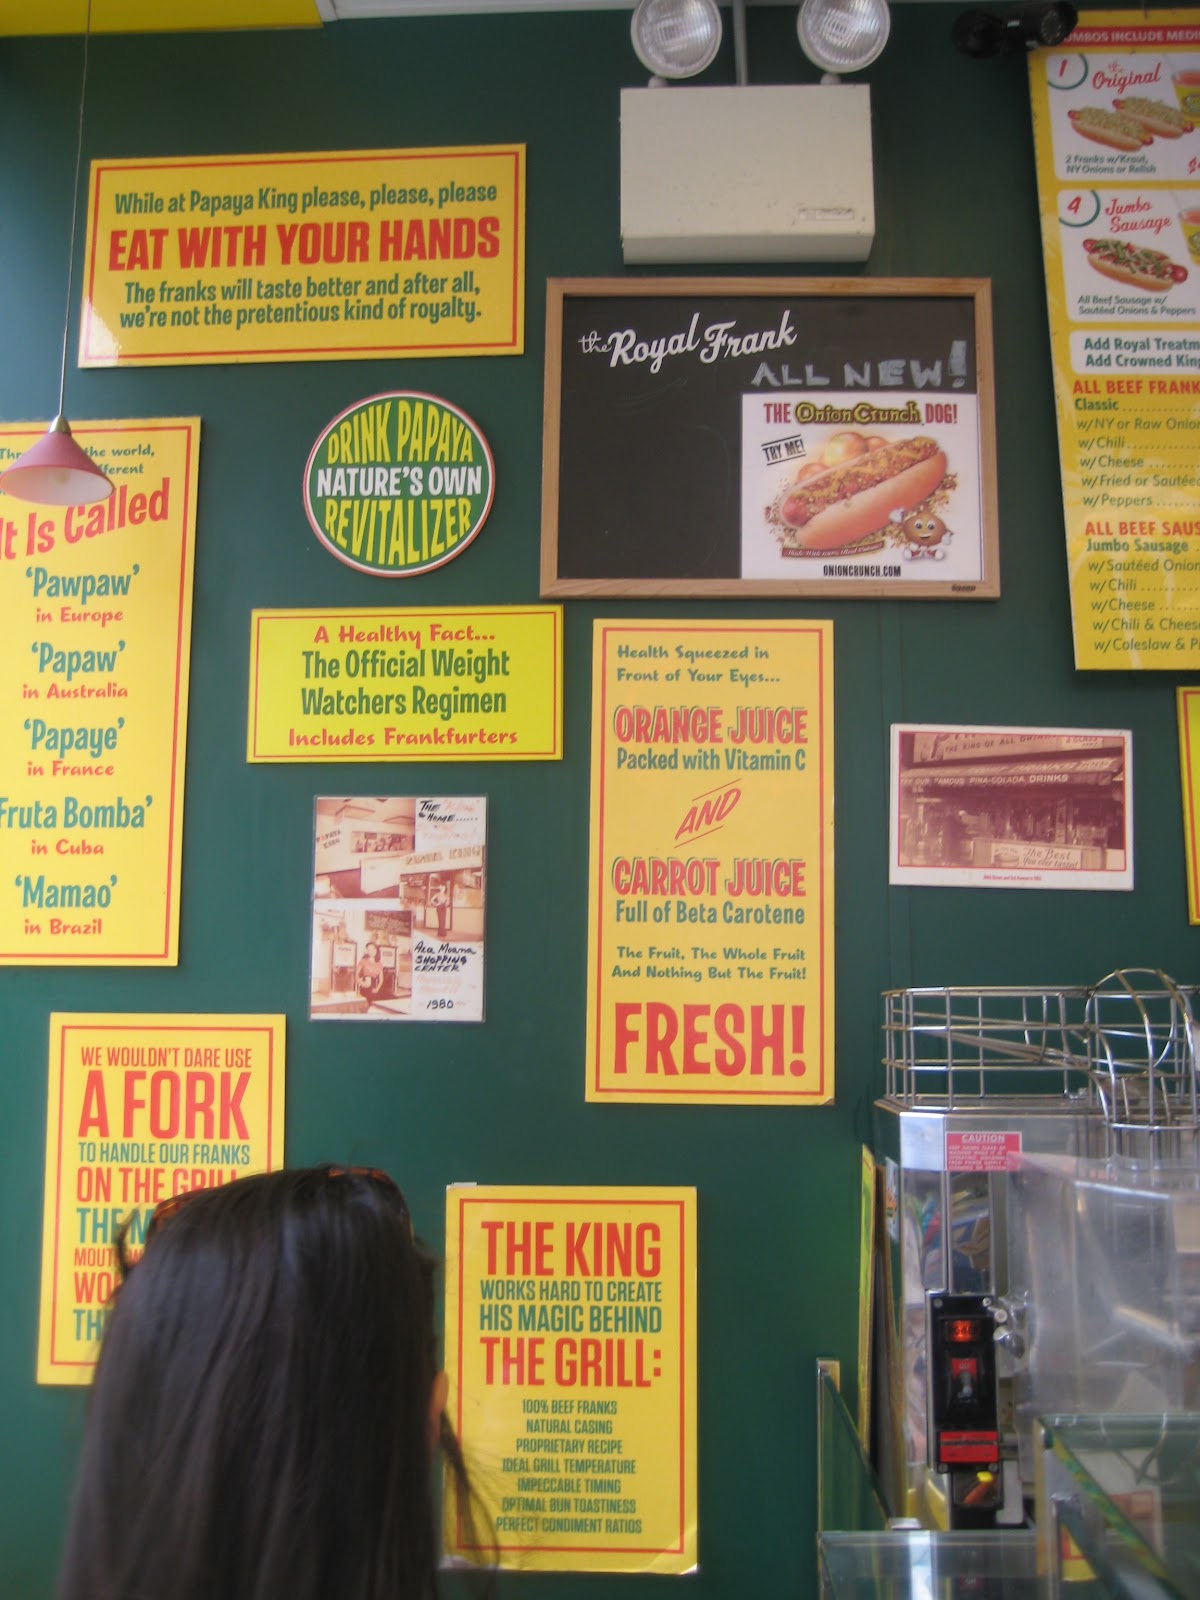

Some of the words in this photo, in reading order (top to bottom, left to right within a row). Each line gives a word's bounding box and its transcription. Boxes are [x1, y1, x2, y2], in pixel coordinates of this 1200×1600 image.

[1059, 60, 1068, 77] 1
[1092, 62, 1162, 94] Original
[114, 192, 164, 215] While
[168, 193, 185, 212] at
[190, 190, 254, 217] Papaya
[258, 187, 298, 213] King
[301, 186, 366, 213] please,
[369, 184, 433, 210] please,
[439, 181, 497, 208] please
[1067, 196, 1081, 214] 4
[1105, 196, 1152, 216] Jumbo
[1110, 216, 1172, 236] Sausage
[108, 229, 168, 271] EAT
[178, 224, 266, 268] WITH
[277, 222, 370, 265] YOUR
[379, 217, 500, 262] HANDS
[125, 282, 155, 305] The
[159, 280, 216, 301] franks
[221, 278, 252, 299] will
[256, 279, 301, 298] taste
[306, 277, 361, 296] better
[365, 274, 398, 295] and
[403, 272, 448, 294] after
[452, 271, 480, 295] all,
[578, 330, 611, 355] the
[608, 312, 701, 374] Royal
[700, 309, 797, 364] Frank
[1084, 338, 1110, 350] Add
[1114, 338, 1150, 352] Royal
[751, 361, 830, 387] ALL
[844, 340, 968, 389] NEW!
[1086, 354, 1112, 367] Add
[1115, 354, 1172, 367] Crowned
[1073, 380, 1101, 394] ALL
[1106, 380, 1143, 394] BEEF
[764, 402, 792, 425] THE
[925, 403, 958, 425] DOG!
[328, 401, 391, 465] DRINK
[397, 400, 473, 463] PAPAYA
[1117, 421, 1129, 429] or
[1134, 419, 1161, 430] Raw
[112, 444, 155, 457] world,
[763, 444, 784, 465] TRY
[785, 438, 806, 456] ME!
[317, 466, 424, 498] NATURE'S
[428, 465, 482, 496] OWN
[26, 512, 55, 556] Is
[64, 477, 170, 544] Called
[325, 497, 472, 566] REVITALIZER
[1085, 522, 1113, 535] ALL
[1120, 522, 1155, 535] BEEF
[1087, 539, 1130, 552] Jumbo
[1134, 539, 1189, 554] Sausage
[823, 565, 901, 577] ONIONCRUNCH.COM
[36, 608, 52, 622] in
[60, 607, 124, 627] Europe
[1144, 619, 1154, 630] &
[314, 626, 330, 643] A
[338, 625, 421, 650] Healthy
[617, 645, 668, 659] Health
[675, 645, 749, 663] Squeezed
[754, 646, 769, 659] in
[302, 651, 340, 678] The
[345, 649, 425, 678] Official
[431, 648, 510, 683] Weight
[23, 684, 39, 699] in
[46, 683, 129, 699] Australia
[301, 687, 406, 715] Watchers
[412, 686, 506, 721] Regimen
[614, 705, 723, 744] ORANGE
[728, 706, 808, 744] JUICE
[289, 728, 375, 746] Includes
[384, 727, 518, 745] Frankfurters
[27, 761, 44, 776] in
[52, 760, 115, 776] France
[617, 747, 678, 770] Packed
[683, 748, 720, 770] with
[725, 748, 791, 770] Vitamin
[795, 748, 806, 771] C
[1029, 774, 1069, 784] DRINKS
[419, 800, 441, 812] THE
[674, 788, 742, 840] AND
[31, 839, 48, 855] in
[55, 838, 104, 855] Cuba
[612, 857, 720, 896] CARROT
[725, 858, 807, 897] JUICE
[24, 918, 41, 935] in
[49, 918, 103, 935] Brazil
[415, 955, 468, 965] SHOPPING
[617, 946, 643, 959] The
[648, 947, 685, 960] Fruit,
[691, 947, 717, 960] The
[723, 948, 767, 960] Whole
[773, 948, 805, 961] Fruit
[426, 1000, 454, 1009] 1980
[614, 1002, 807, 1078] FRESH!
[78, 1070, 109, 1137] A
[123, 1070, 252, 1140] FORK
[961, 1134, 1005, 1143] CAUTION
[78, 1142, 96, 1162] TO
[100, 1143, 155, 1163] HANDLE
[159, 1144, 189, 1164] OUR
[193, 1144, 251, 1165] FRANKS
[76, 1167, 112, 1203] ON
[119, 1167, 165, 1203] THE
[481, 1221, 554, 1276] THE
[566, 1222, 661, 1278] KING
[480, 1336, 545, 1386] THE
[555, 1337, 662, 1388] GRILL:
[522, 1399, 549, 1414] 100%
[551, 1399, 575, 1414] BEEF
[577, 1400, 618, 1415] FRANKS
[526, 1419, 571, 1434] NATURAL
[574, 1419, 613, 1435] CASING
[516, 1438, 585, 1454] PROPRIETARY
[587, 1439, 623, 1454] RECIPE
[502, 1458, 529, 1473] IDEAL
[533, 1459, 560, 1473] GRILL
[563, 1459, 636, 1474] TEMPERATURE
[517, 1478, 581, 1493] IMPECCABLE
[584, 1479, 621, 1494] TIMING
[502, 1497, 547, 1513] OPTIMAL
[549, 1498, 571, 1513] BUN
[573, 1498, 636, 1514] TOASTINESS
[496, 1517, 539, 1532] PERFECT
[542, 1518, 602, 1533] CONDIMENT
[605, 1519, 642, 1534] RATIOS
